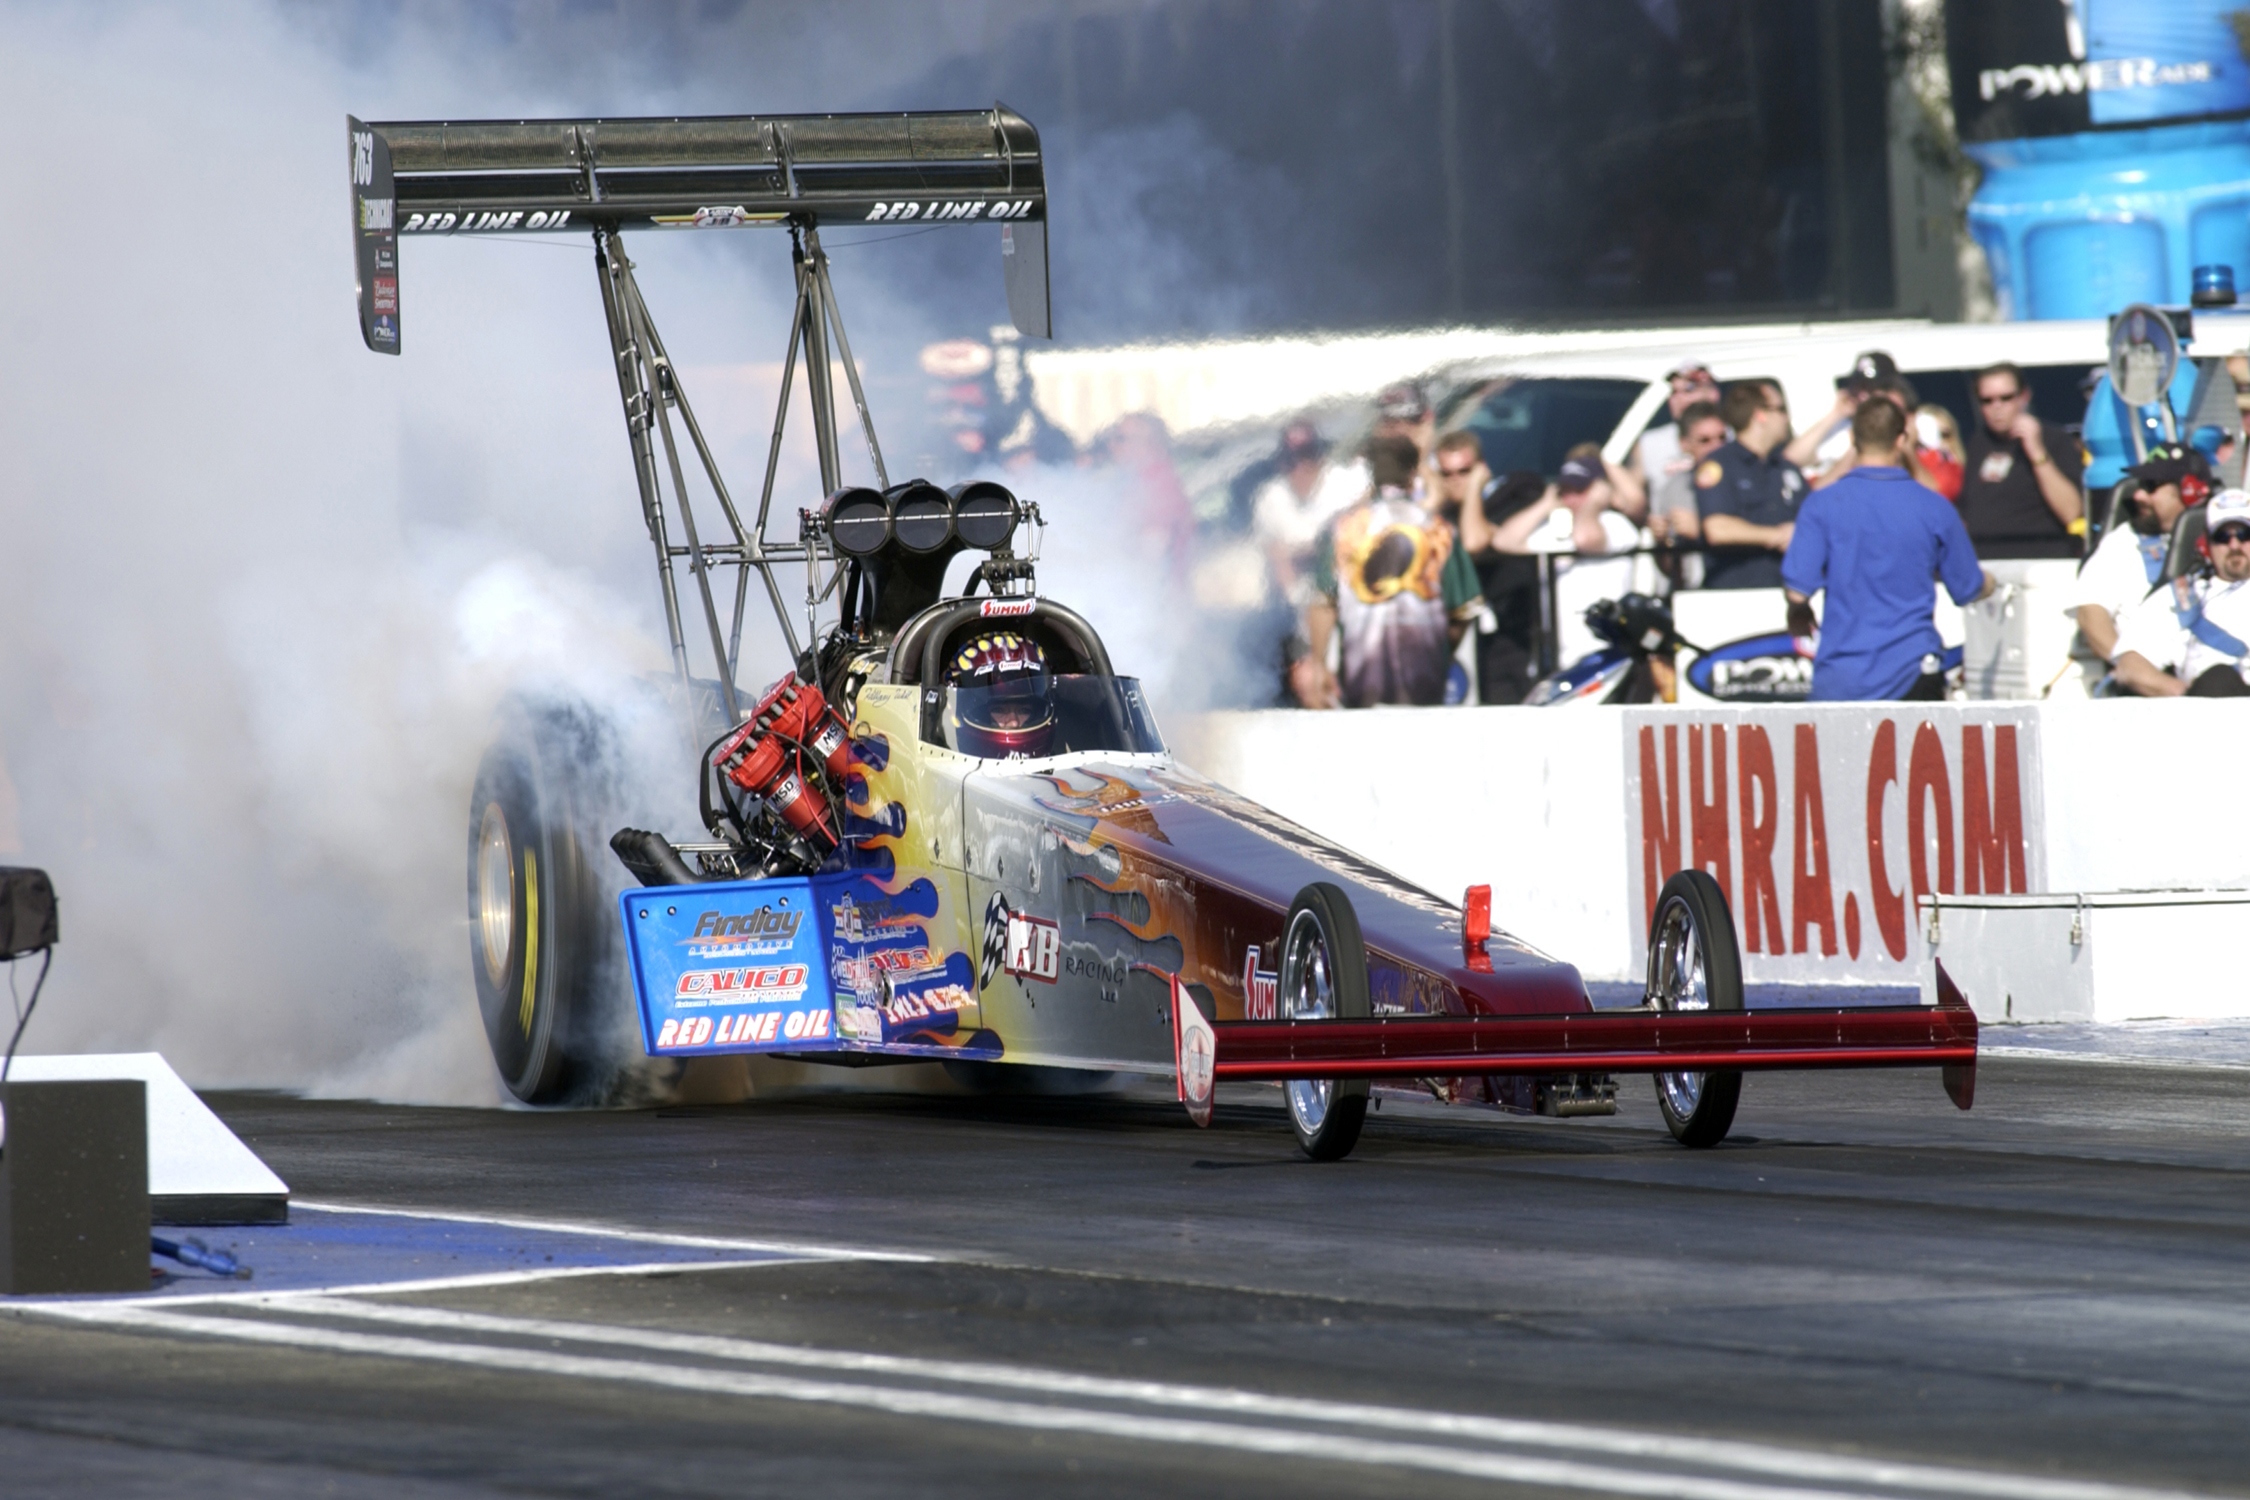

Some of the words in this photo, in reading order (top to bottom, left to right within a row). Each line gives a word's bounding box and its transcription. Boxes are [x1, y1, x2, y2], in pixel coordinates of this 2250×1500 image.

[402, 213, 456, 231] RED
[458, 211, 524, 230] LINE
[525, 210, 571, 229] OIL
[865, 202, 919, 221] RED
[920, 201, 986, 219] LINE
[987, 201, 1032, 219] OIL
[983, 601, 1031, 617] SUMMIT
[771, 780, 795, 805] MSD
[1639, 718, 2028, 962] NHRA.COM
[692, 907, 804, 940] Findlay
[677, 965, 807, 995] CALICO
[1065, 956, 1124, 986] RACING
[656, 1016, 714, 1048] RED
[714, 1012, 783, 1044] LINE
[784, 1008, 831, 1040] OIL
